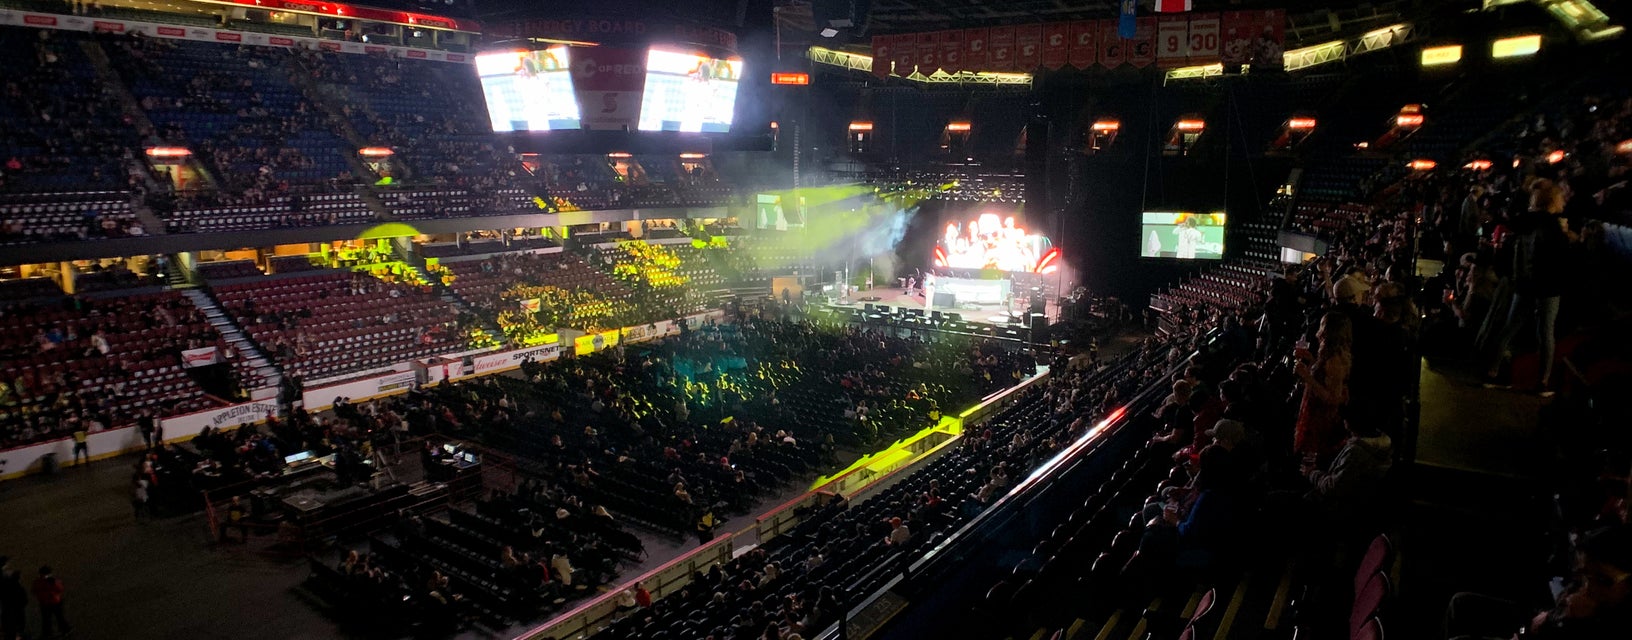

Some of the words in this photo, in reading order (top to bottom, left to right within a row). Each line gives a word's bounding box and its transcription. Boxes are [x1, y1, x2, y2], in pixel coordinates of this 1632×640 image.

[589, 20, 646, 34] BOARD
[1167, 36, 1178, 52] 9
[1192, 33, 1217, 51] 30
[513, 345, 559, 360] SPORTSNET
[212, 405, 250, 425] APPLETON
